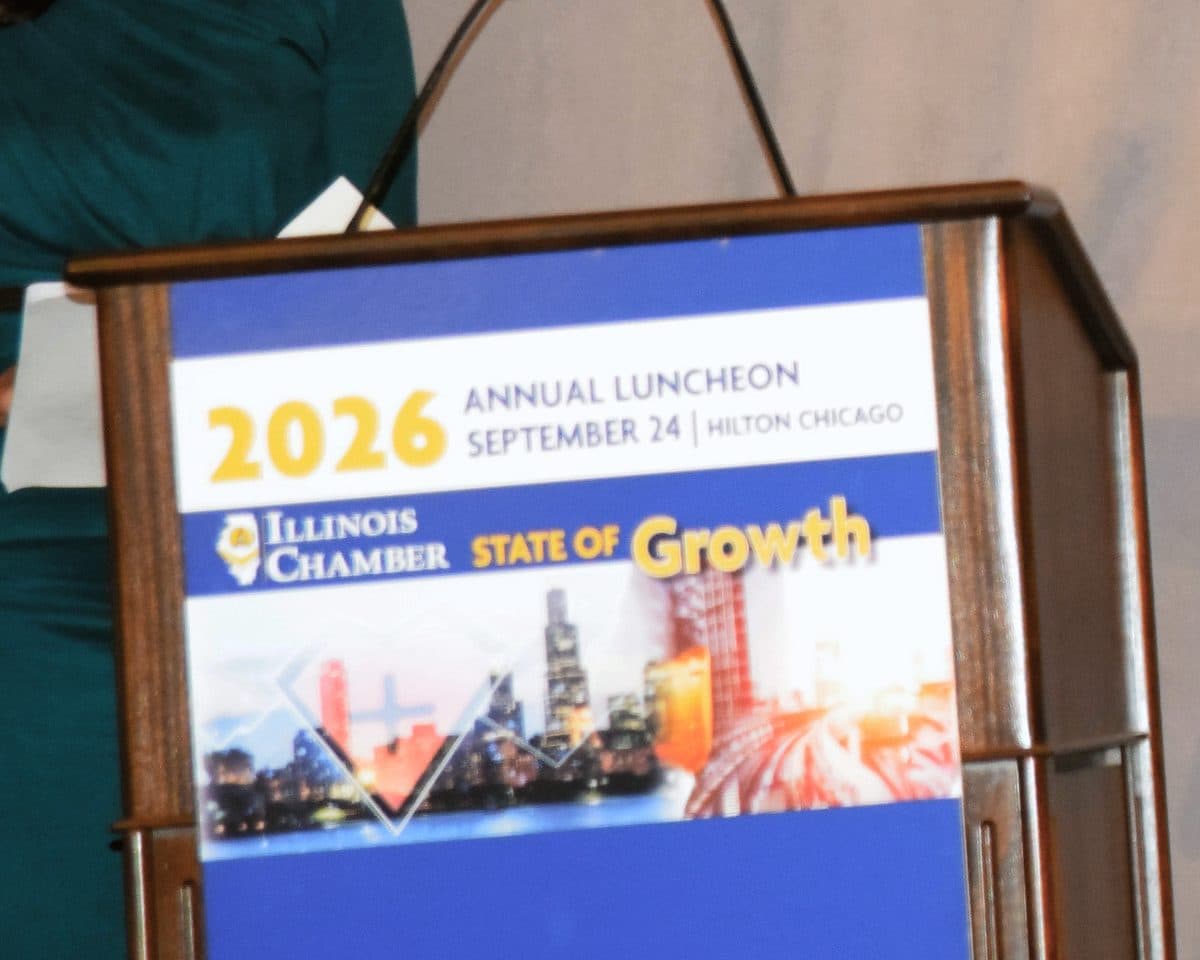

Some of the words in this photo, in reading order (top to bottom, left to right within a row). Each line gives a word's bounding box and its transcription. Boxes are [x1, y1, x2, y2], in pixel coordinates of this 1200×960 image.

[464, 377, 603, 413] ANNUAL
[615, 361, 799, 402] LUNCHEON
[208, 390, 446, 483] 2026
[467, 418, 638, 458] SEPTEMBER
[649, 414, 682, 443] 24
[707, 410, 791, 437] HILTON
[799, 402, 905, 430] CHICAGO
[264, 507, 418, 545] ILLINOIS
[472, 530, 567, 568] STATE
[573, 525, 620, 559] OF
[632, 496, 872, 579] Growth
[265, 542, 451, 582] CHAMBER
